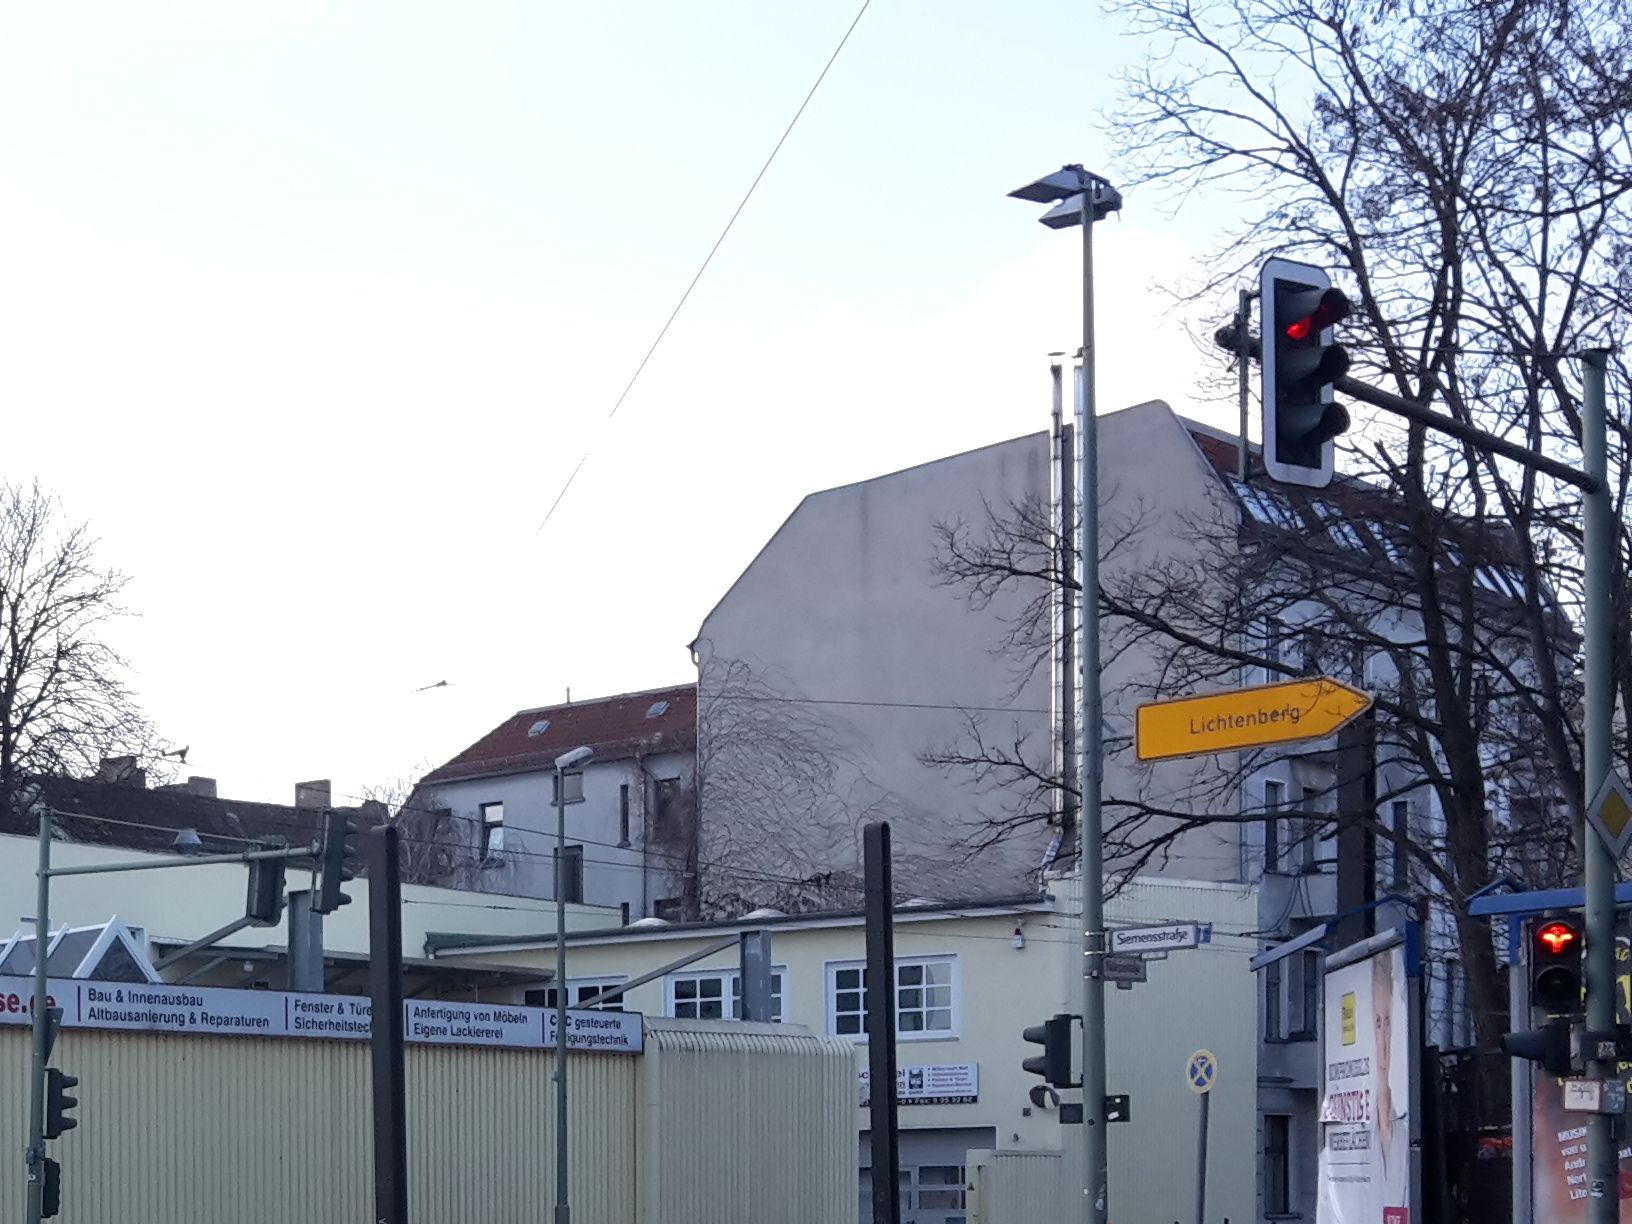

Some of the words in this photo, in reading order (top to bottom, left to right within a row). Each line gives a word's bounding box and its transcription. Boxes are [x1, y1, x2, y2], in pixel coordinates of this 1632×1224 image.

[1188, 705, 1301, 735] Lichtenberg
[88, 988, 112, 1003] Bau
[116, 989, 124, 1003] &
[128, 990, 203, 1007] Innenausbau
[294, 999, 335, 1014] Fenster
[337, 1002, 345, 1015] &
[349, 1002, 372, 1016] Türe
[413, 1006, 471, 1023] Anfertigung
[493, 1009, 528, 1024] Möbeln
[88, 1007, 186, 1027] Altbausanierung
[189, 1012, 197, 1025] &
[200, 1011, 270, 1029] Reparaturen
[294, 1016, 372, 1033] Sicherheitstec
[549, 1015, 572, 1027] CC
[574, 1017, 622, 1031] gesteuerte
[413, 1023, 448, 1039] Eigene
[451, 1025, 504, 1039] Lackiererei
[549, 1030, 630, 1048] Figungstechnik
